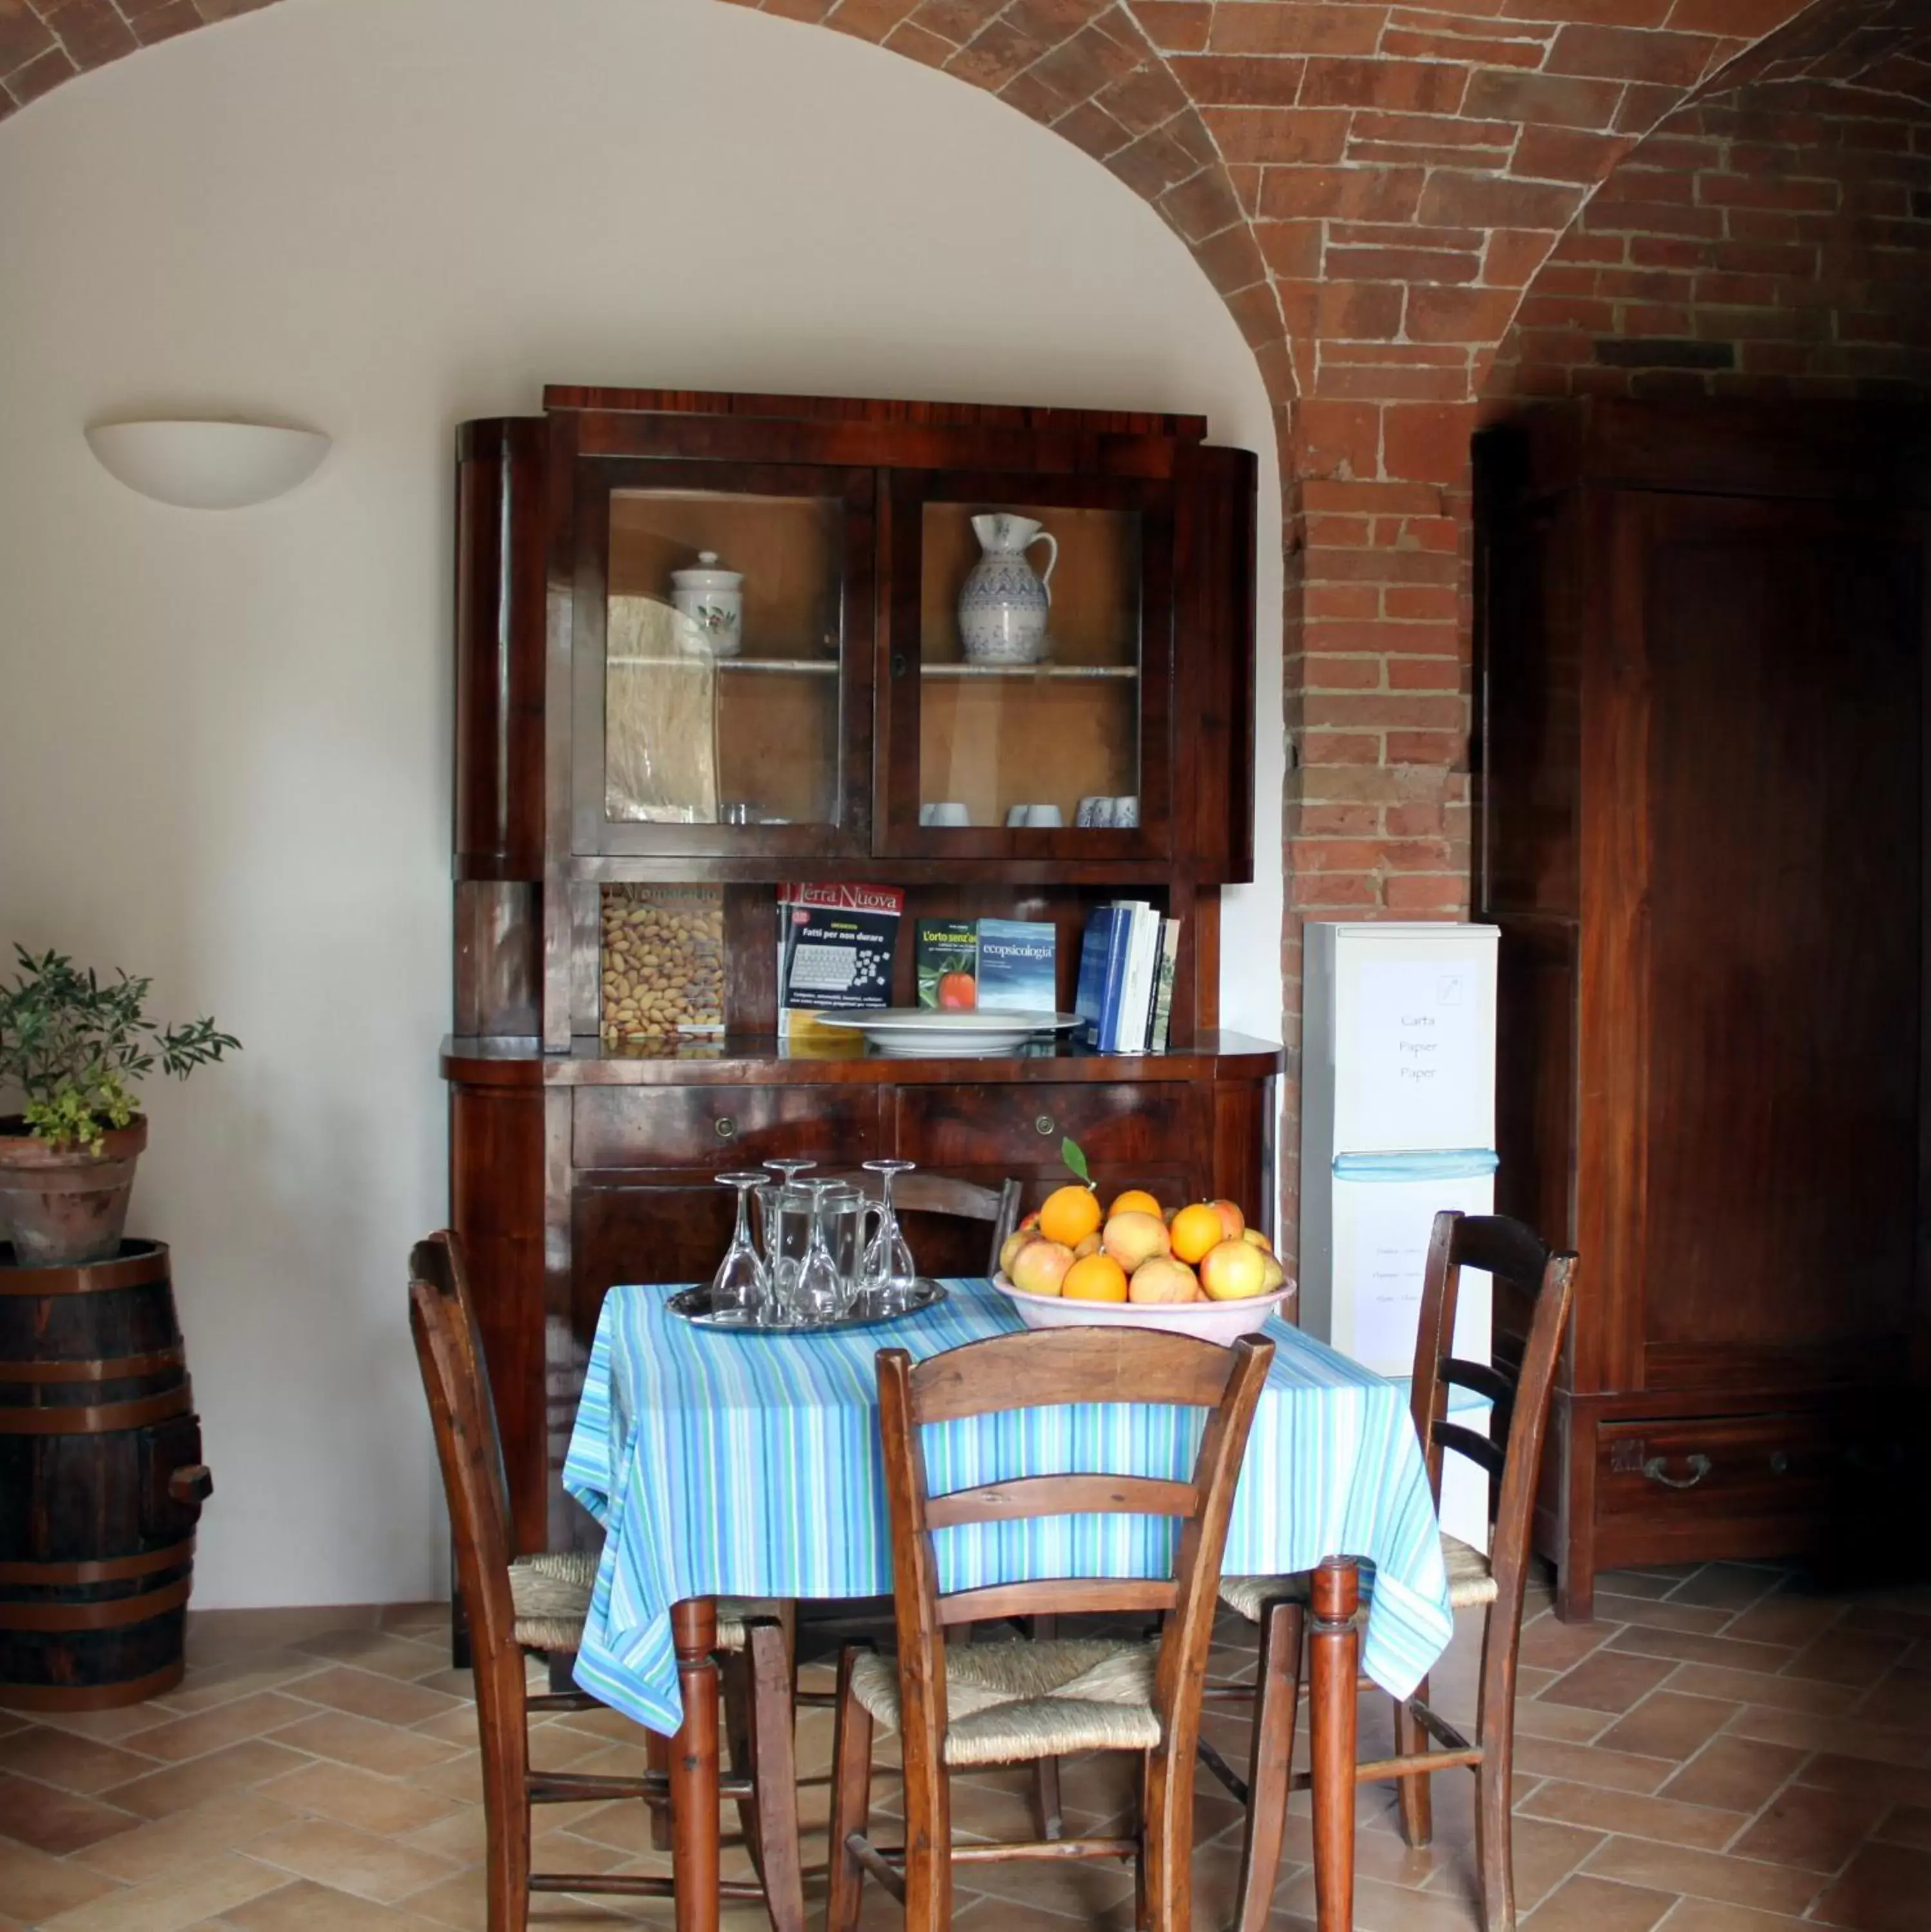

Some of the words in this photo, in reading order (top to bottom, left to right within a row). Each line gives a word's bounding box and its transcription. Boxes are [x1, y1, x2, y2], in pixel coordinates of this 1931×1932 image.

[796, 883, 838, 905] Terra
[839, 885, 897, 909] Nuova
[803, 927, 823, 937] Fatti
[823, 931, 838, 940] per
[856, 932, 884, 942] durare
[923, 931, 947, 942] L'orto
[984, 943, 1052, 960] ecopsicologia
[1401, 1015, 1436, 1027] Carta
[1400, 1066, 1437, 1083] Paper
